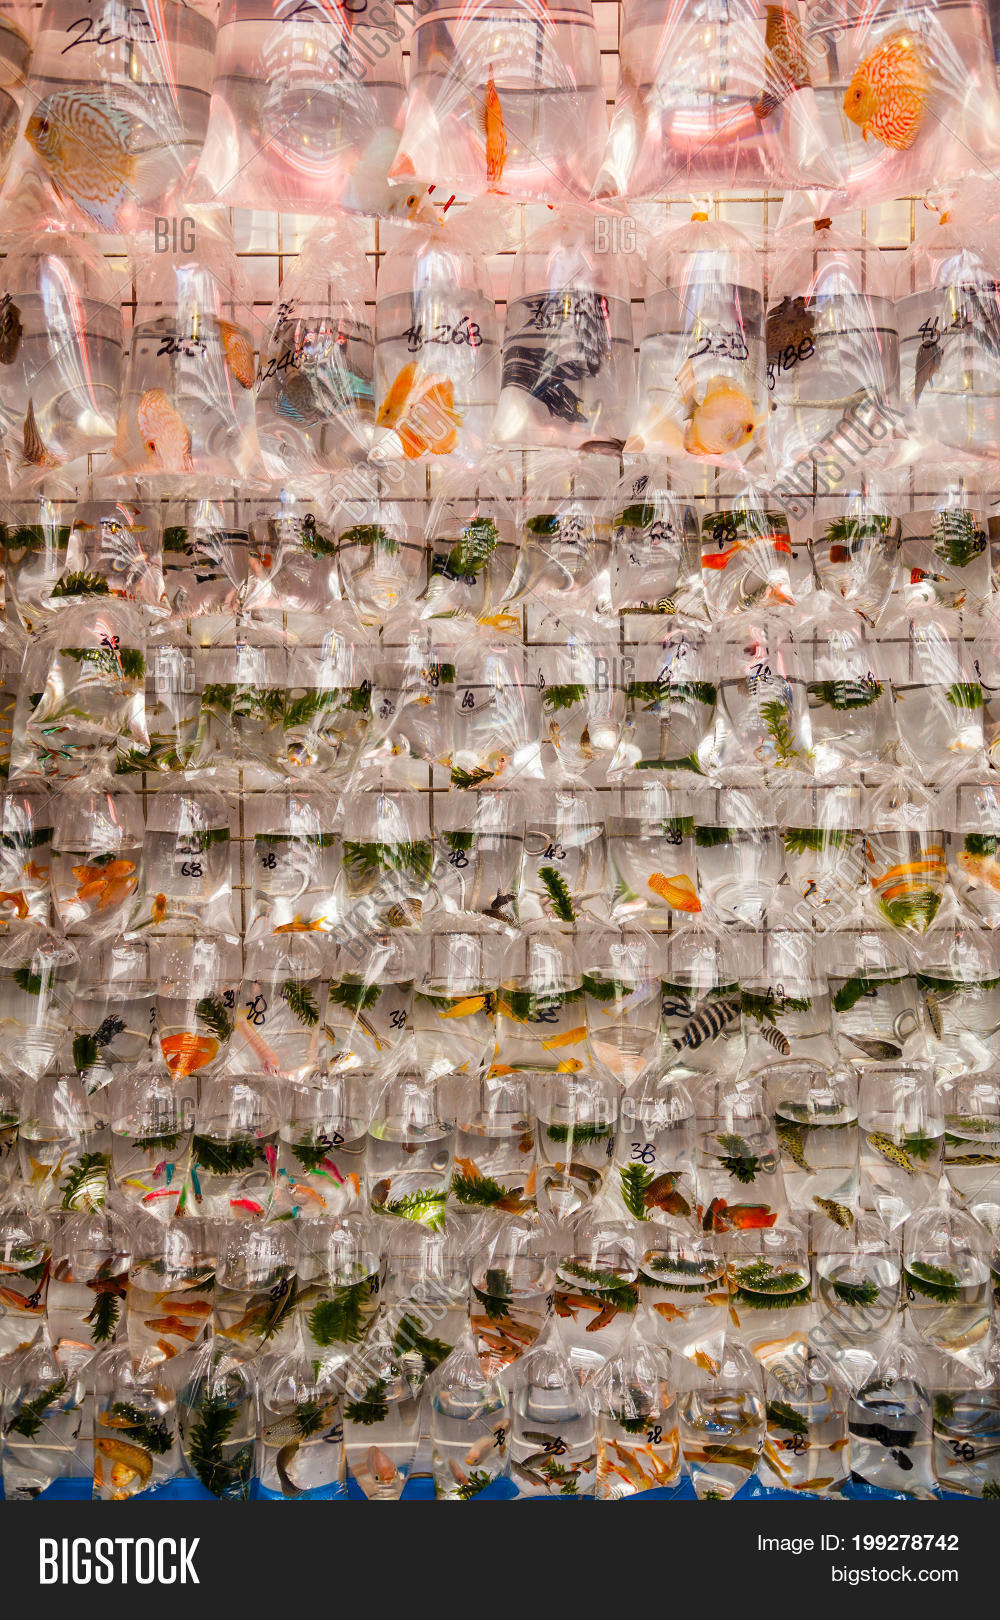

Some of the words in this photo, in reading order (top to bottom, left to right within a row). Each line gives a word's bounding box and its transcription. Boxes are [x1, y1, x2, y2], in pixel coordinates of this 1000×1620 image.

[448, 849, 469, 868] 28
[181, 862, 203, 878] 68
[389, 1009, 408, 1030] 38
[630, 1142, 656, 1164] 38
[648, 1425, 663, 1445] 28
[949, 1439, 975, 1461] 38
